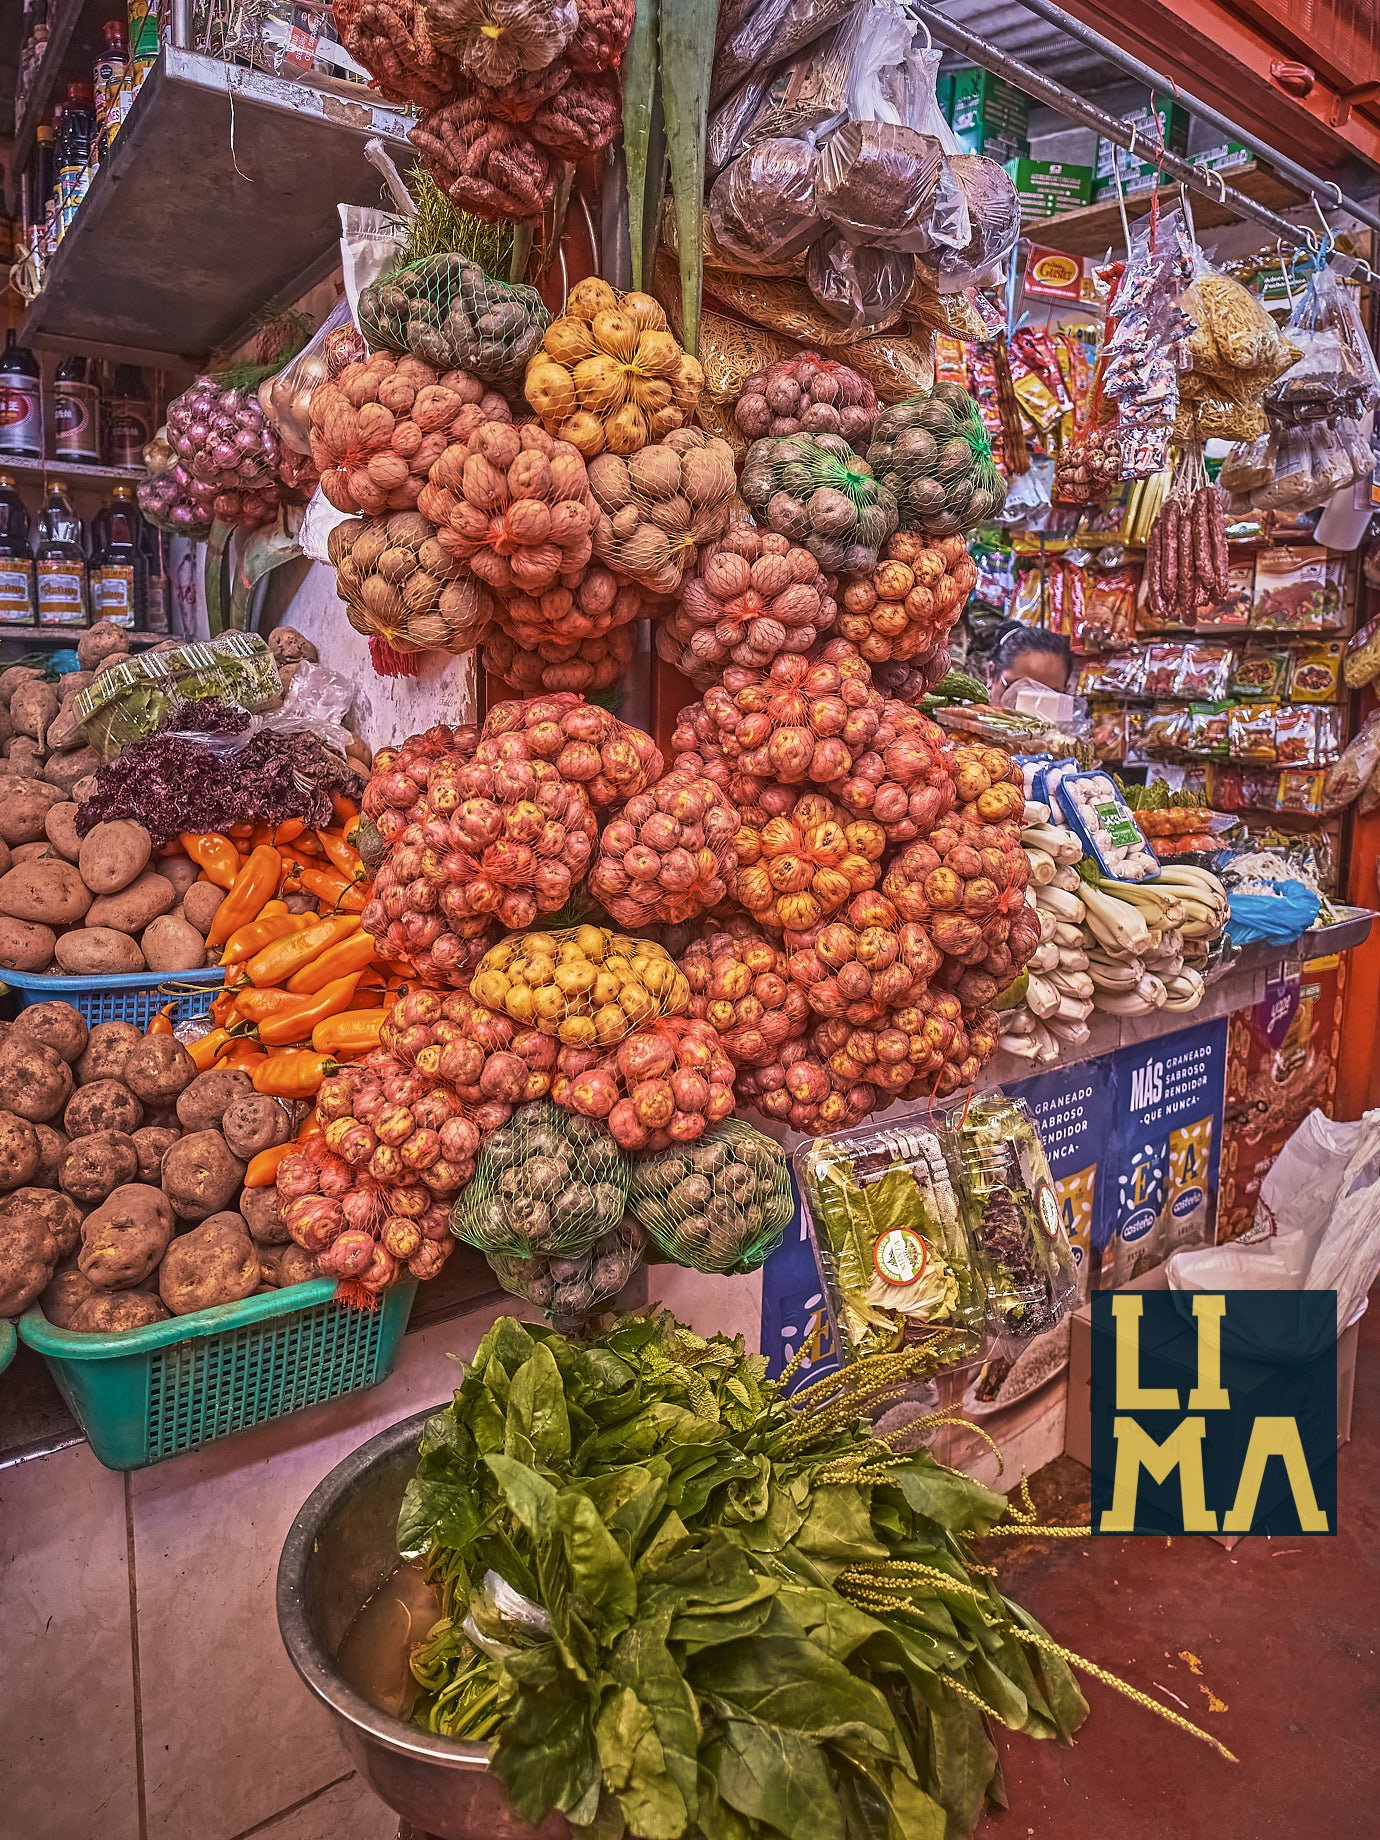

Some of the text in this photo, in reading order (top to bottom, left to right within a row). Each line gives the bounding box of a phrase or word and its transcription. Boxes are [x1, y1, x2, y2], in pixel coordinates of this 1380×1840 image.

[1166, 1046, 1212, 1069] GRANEADO
[1129, 1057, 1164, 1112] MÁS
[1165, 1063, 1206, 1084] SABROSO
[1164, 1075, 1208, 1099] RENDIDOR
[1035, 1086, 1093, 1115] GRANEADO
[1039, 1106, 1084, 1131] ABROSO
[1042, 1120, 1088, 1146] ENDIDOR
[1123, 1211, 1155, 1237] costeño
